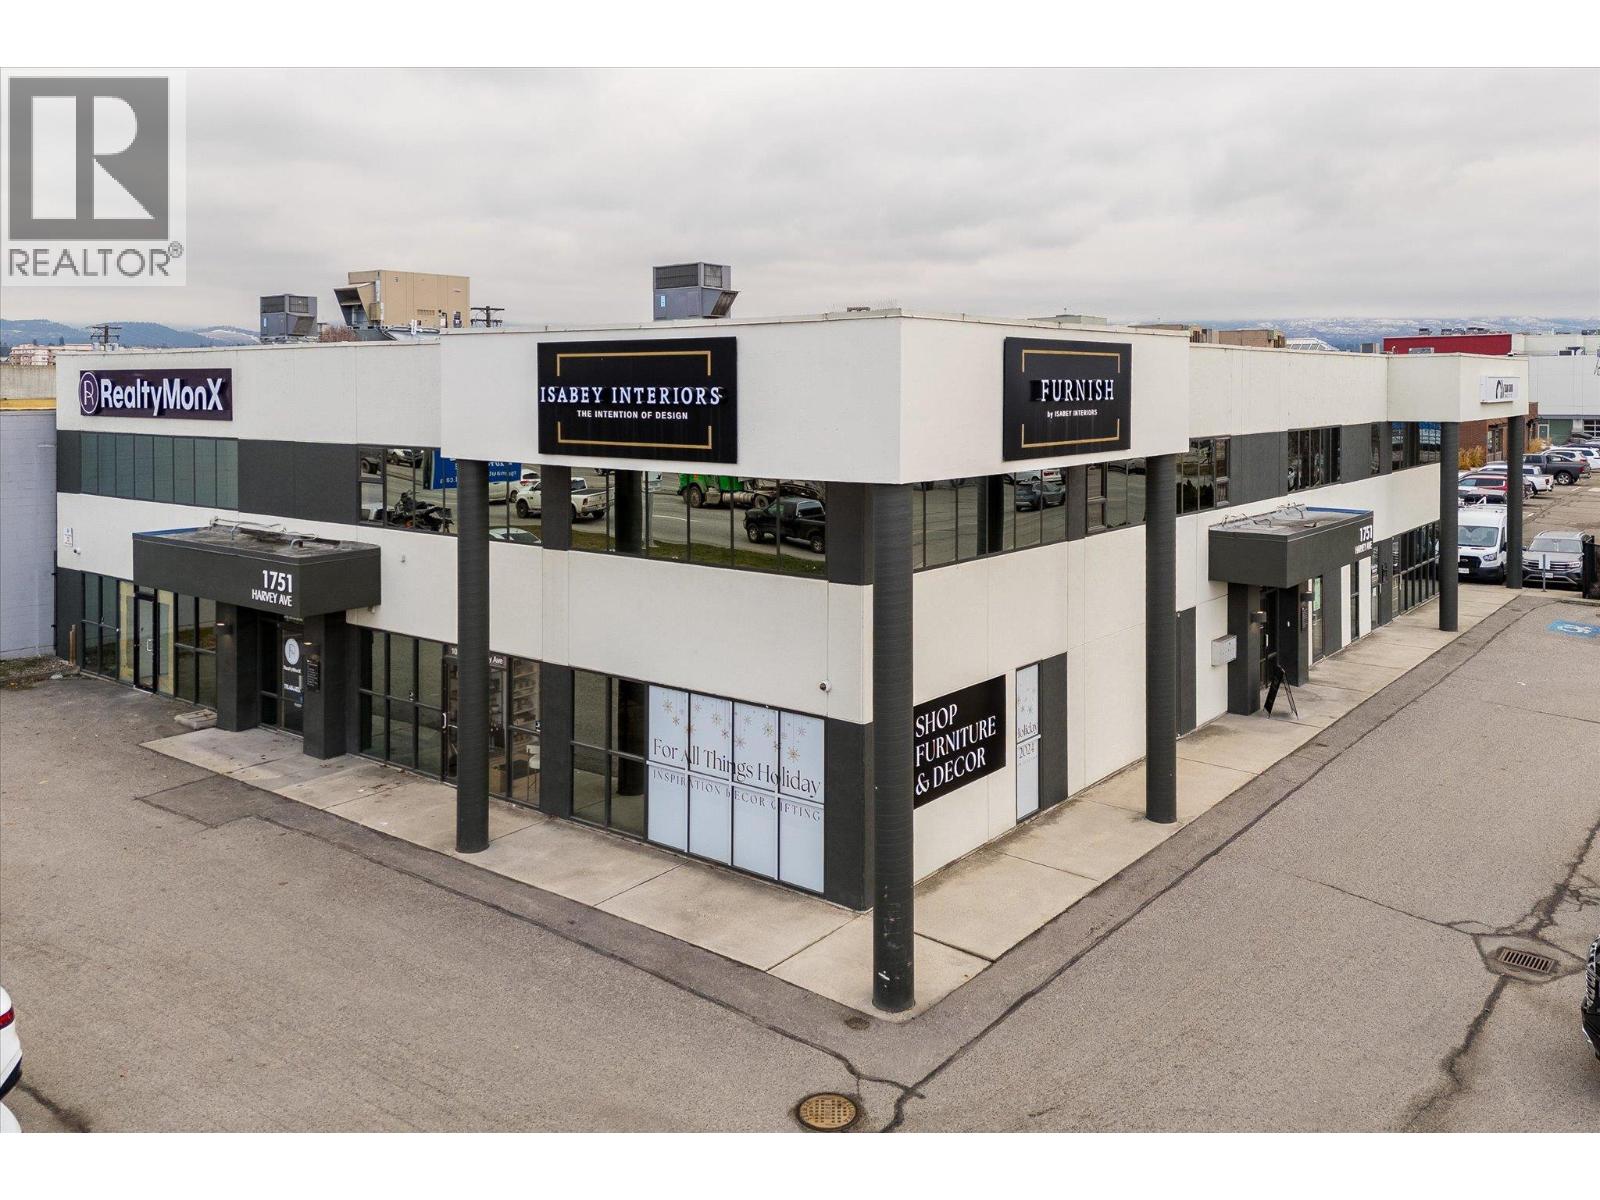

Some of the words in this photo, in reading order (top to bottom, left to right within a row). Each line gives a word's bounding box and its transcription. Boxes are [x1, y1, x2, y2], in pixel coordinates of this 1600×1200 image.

[101, 378, 223, 416] RealtyMonX
[540, 386, 603, 403] ISABEY
[611, 386, 720, 405] INTERIORS
[1041, 379, 1115, 402] FURNISH
[577, 410, 592, 418] THE
[594, 410, 638, 419] INTENTION
[641, 411, 653, 419] OF
[655, 411, 688, 420] DESIGN
[1047, 411, 1054, 419] by
[1054, 410, 1072, 418] ISABEY
[1073, 409, 1098, 417] INTERIORS
[1360, 524, 1373, 542] 1751
[262, 569, 293, 593] 1751
[251, 588, 278, 604] HARVEY
[278, 593, 293, 607] AVE
[915, 703, 958, 738] SHOP
[915, 715, 997, 768] FURNITURE
[653, 738, 678, 760] For
[680, 744, 700, 766] All
[703, 749, 754, 783] Things
[757, 763, 821, 798] Holiday
[915, 772, 930, 796] &
[933, 747, 986, 789] DECOR
[653, 769, 721, 795] INSPIRATION
